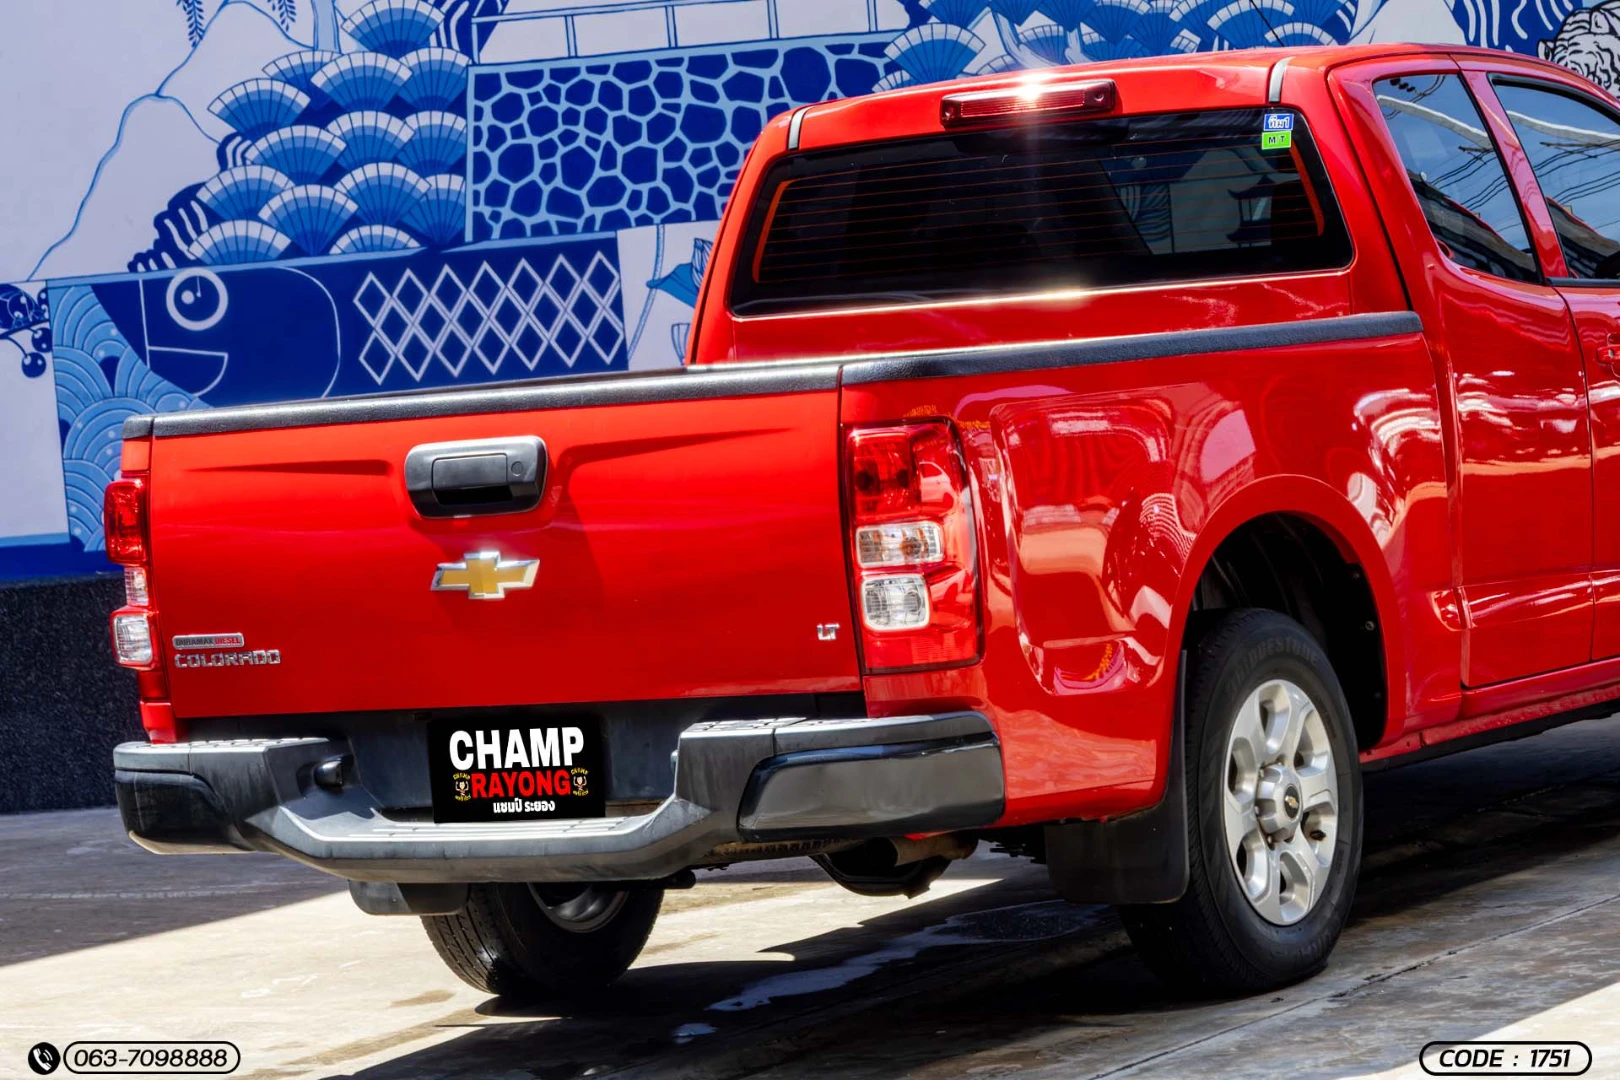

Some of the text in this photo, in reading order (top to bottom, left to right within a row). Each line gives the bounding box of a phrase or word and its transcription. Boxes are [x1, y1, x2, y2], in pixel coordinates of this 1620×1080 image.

[175, 636, 241, 646] DURAMAX DIESEL
[816, 623, 840, 641] LT
[174, 649, 281, 668] COLORADO
[449, 727, 584, 770] CHAMP
[471, 769, 571, 798] RAYONG
[493, 797, 556, 814] แชมป์ ระยอง
